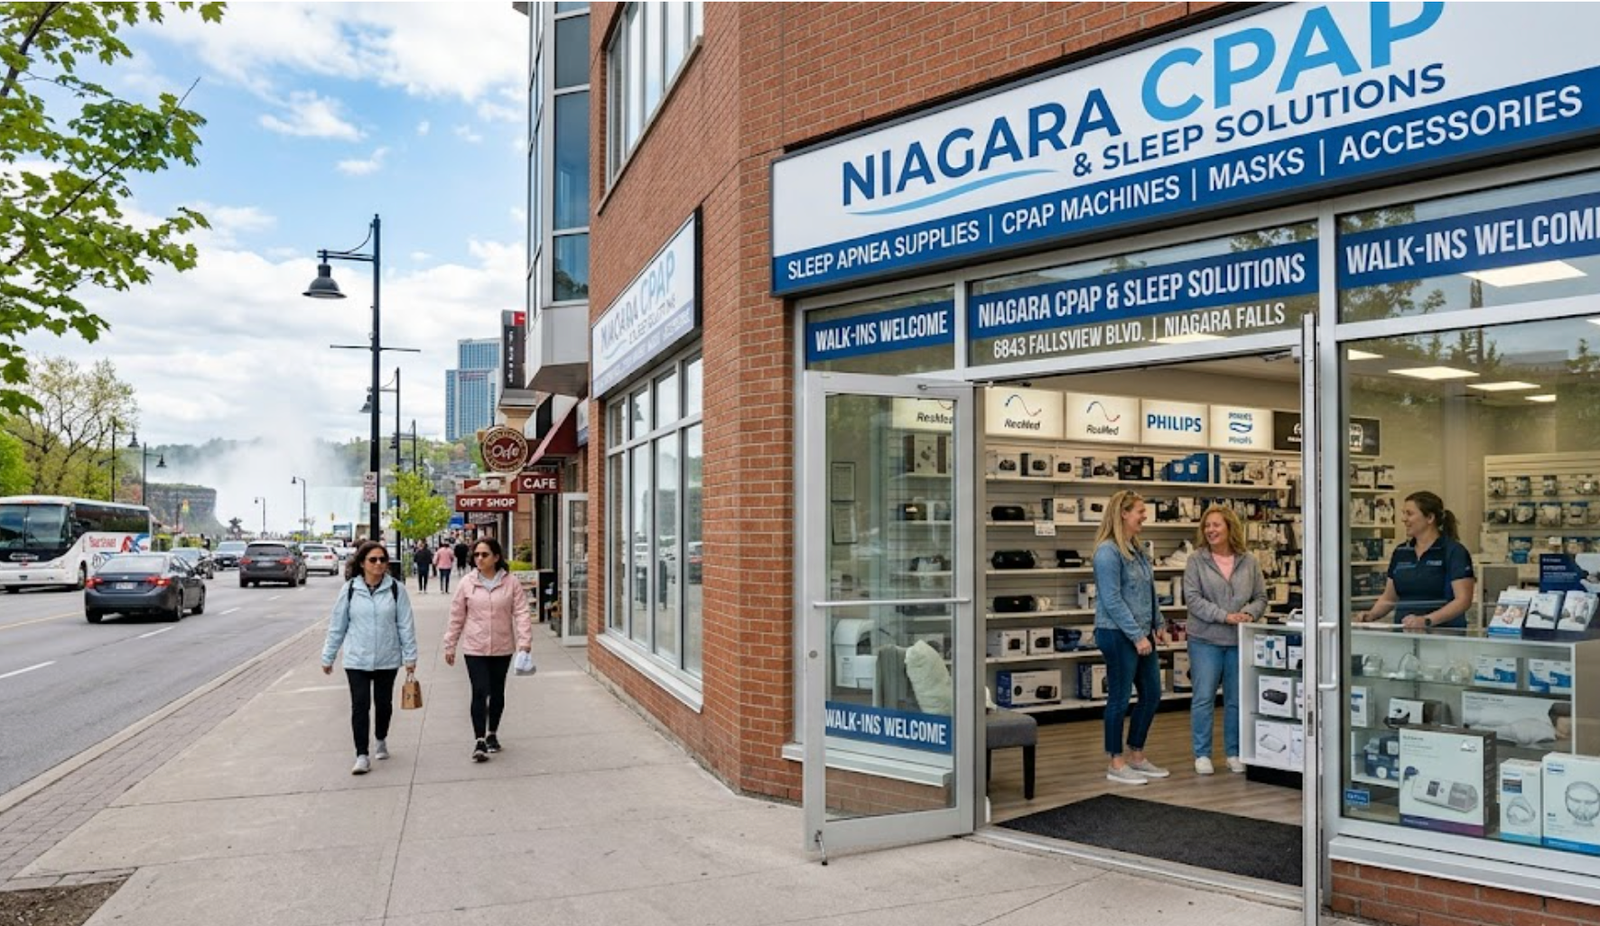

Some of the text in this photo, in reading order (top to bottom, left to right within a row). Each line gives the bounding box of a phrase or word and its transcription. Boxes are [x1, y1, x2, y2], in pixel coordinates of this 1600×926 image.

[842, 2, 1444, 207] NIAGARA CPAP
[1072, 63, 1446, 177] & SLEEP SOLUTIONS
[788, 84, 1583, 281] SLEEP APNEA SUPPLIES CPAP MACHINES MASKS ACCESSORIES
[1346, 228, 1467, 275] WALK-INS
[640, 250, 676, 316] CPAP
[978, 252, 1306, 329] NIAGARA CPAP & SLEEP SOLUTIONS
[815, 310, 948, 352] WALK-INS WELCOME
[993, 302, 1286, 359] 6843 FALLSVIEW BLVD. NIAGARA FALLS
[1147, 414, 1202, 432] PHILIPS
[487, 498, 516, 508] SHOP
[523, 477, 557, 489] CAFE
[825, 708, 947, 745] WALK-INS WELCOME
